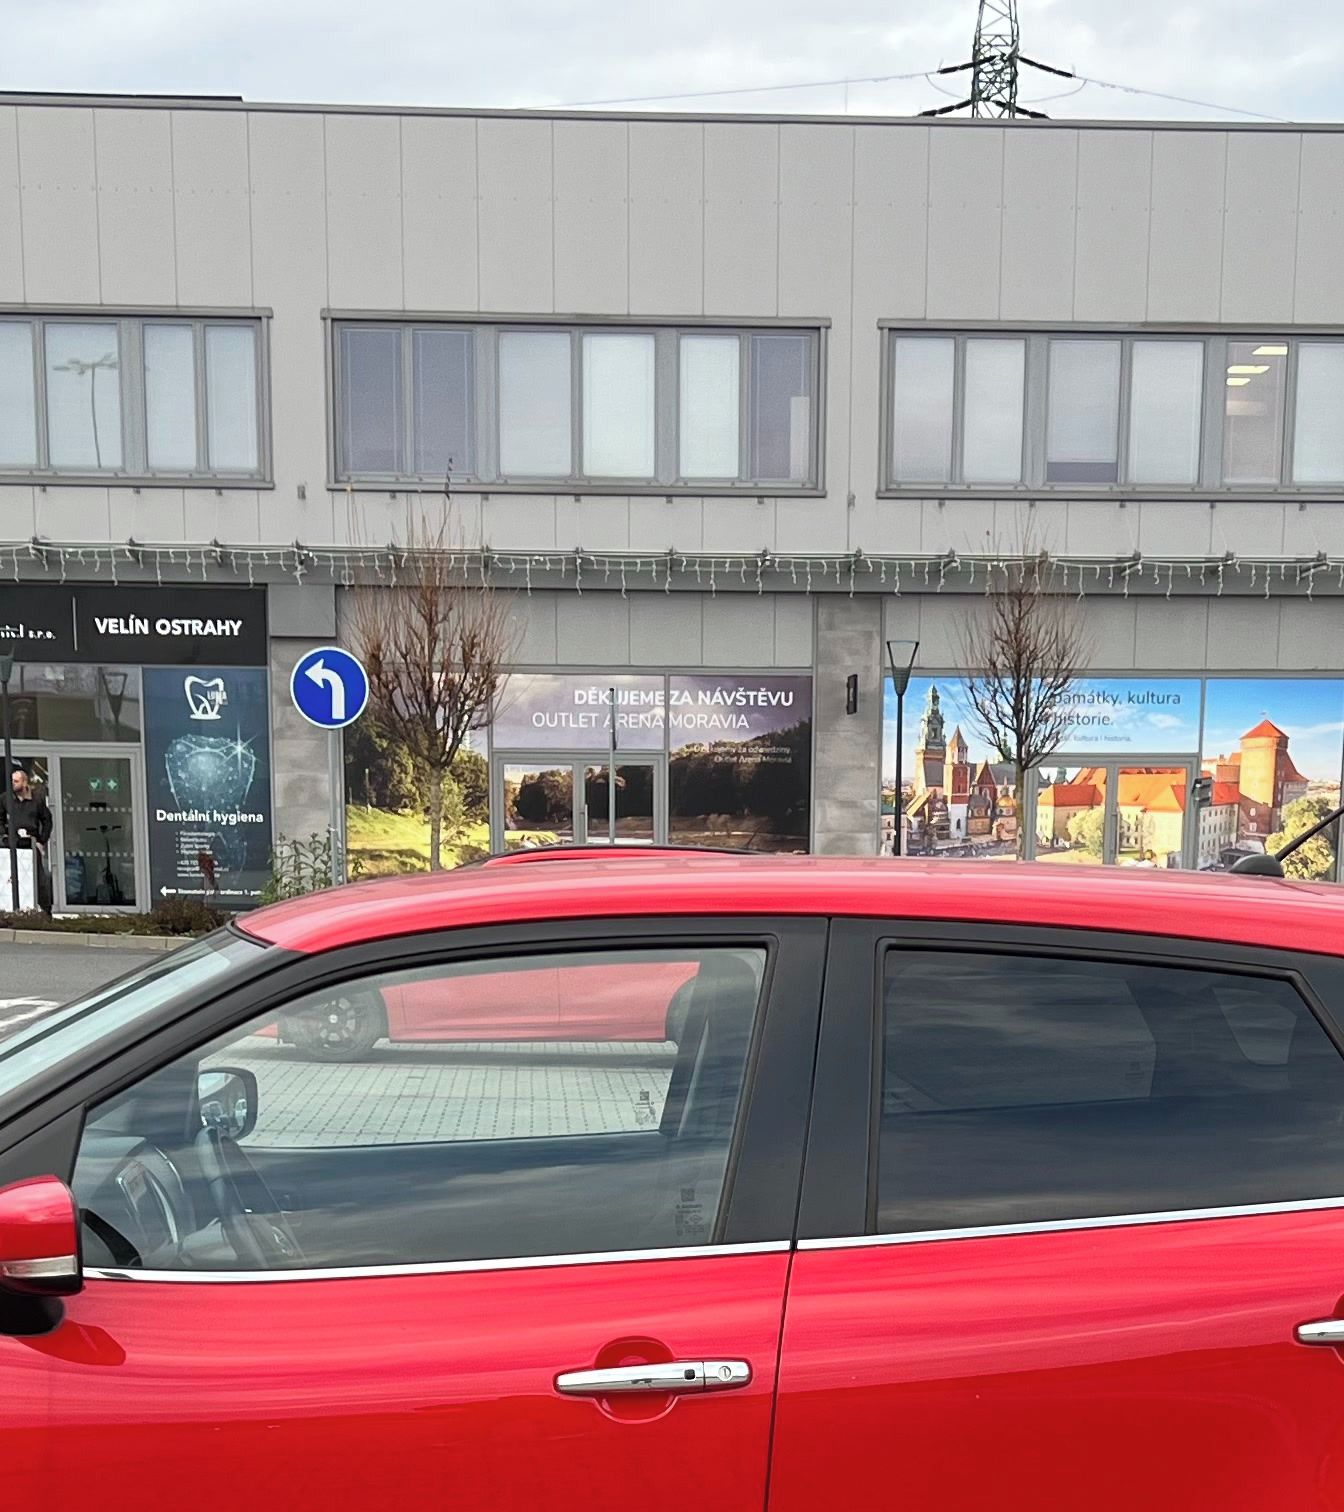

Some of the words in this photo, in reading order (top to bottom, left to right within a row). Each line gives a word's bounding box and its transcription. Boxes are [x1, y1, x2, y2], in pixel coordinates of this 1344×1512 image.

[94, 614, 149, 634] VELÍN
[155, 619, 242, 636] OSTRAHY
[669, 690, 693, 705] ZA
[698, 686, 794, 706] NÁVŠTĚVU
[1127, 691, 1181, 705] kultura
[532, 712, 598, 727] OUTLET
[603, 713, 664, 728] ARENA
[669, 712, 750, 729] MORAVIA
[156, 809, 211, 822] Dentální
[213, 810, 264, 826] hygiena
